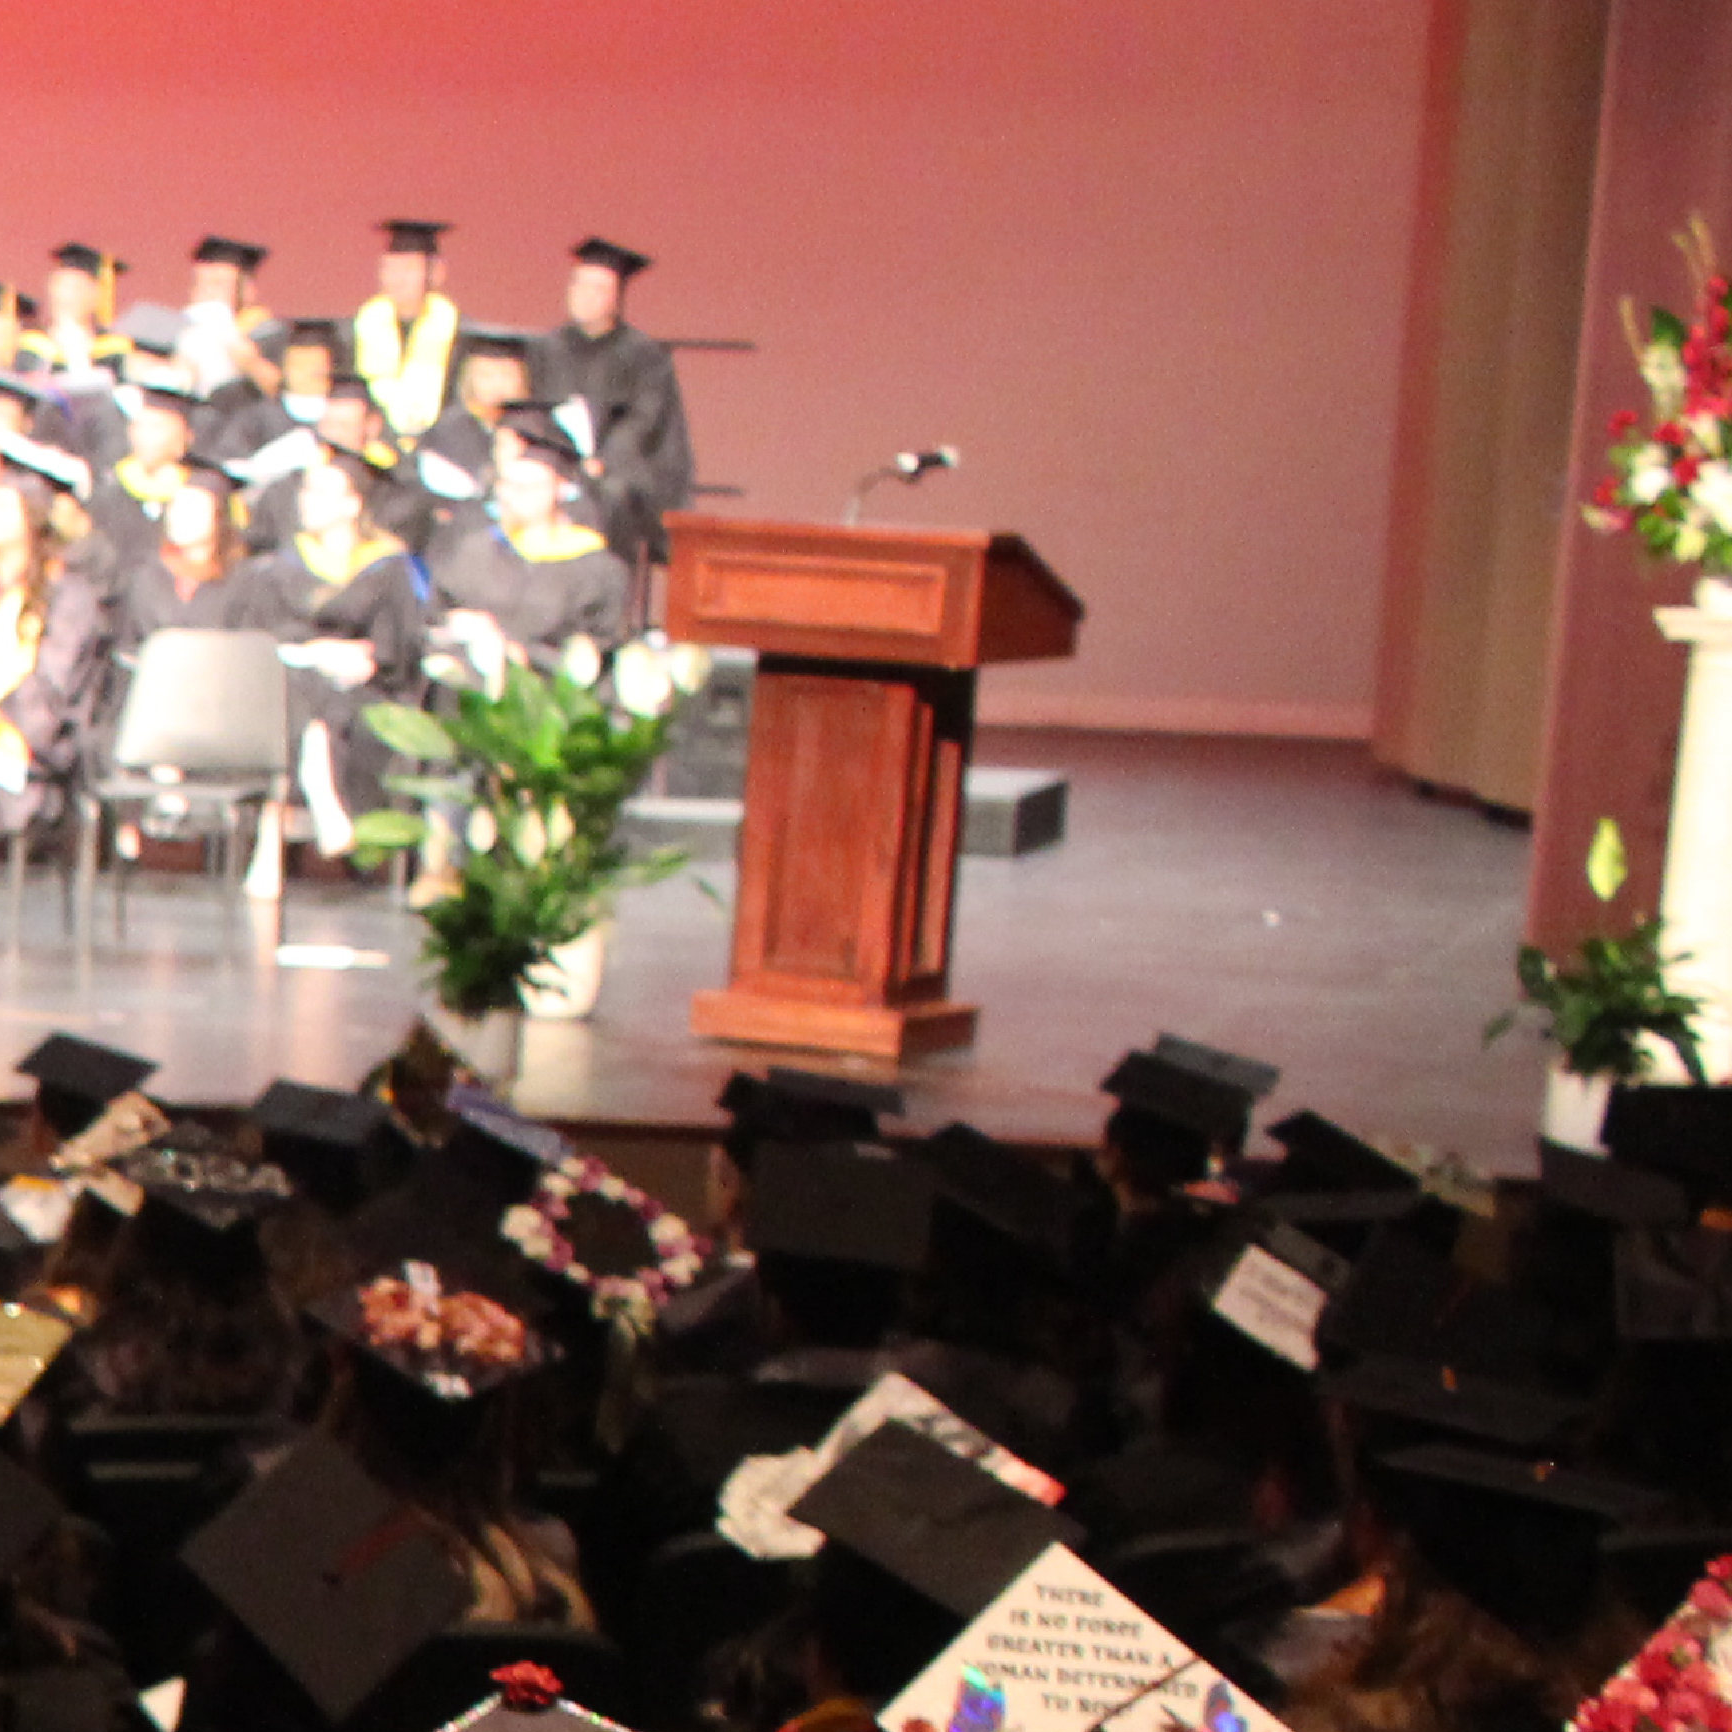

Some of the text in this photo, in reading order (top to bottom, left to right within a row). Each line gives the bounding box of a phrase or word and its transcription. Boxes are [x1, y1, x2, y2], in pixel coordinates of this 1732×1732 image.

[1035, 1582, 1106, 1607] THERE
[1008, 1609, 1142, 1638] IS NO FORCE
[985, 1633, 1085, 1658] GREATER
[1092, 1644, 1152, 1665] THAN
[966, 1659, 1049, 1682] OMAN
[1041, 1692, 1071, 1711] TO
